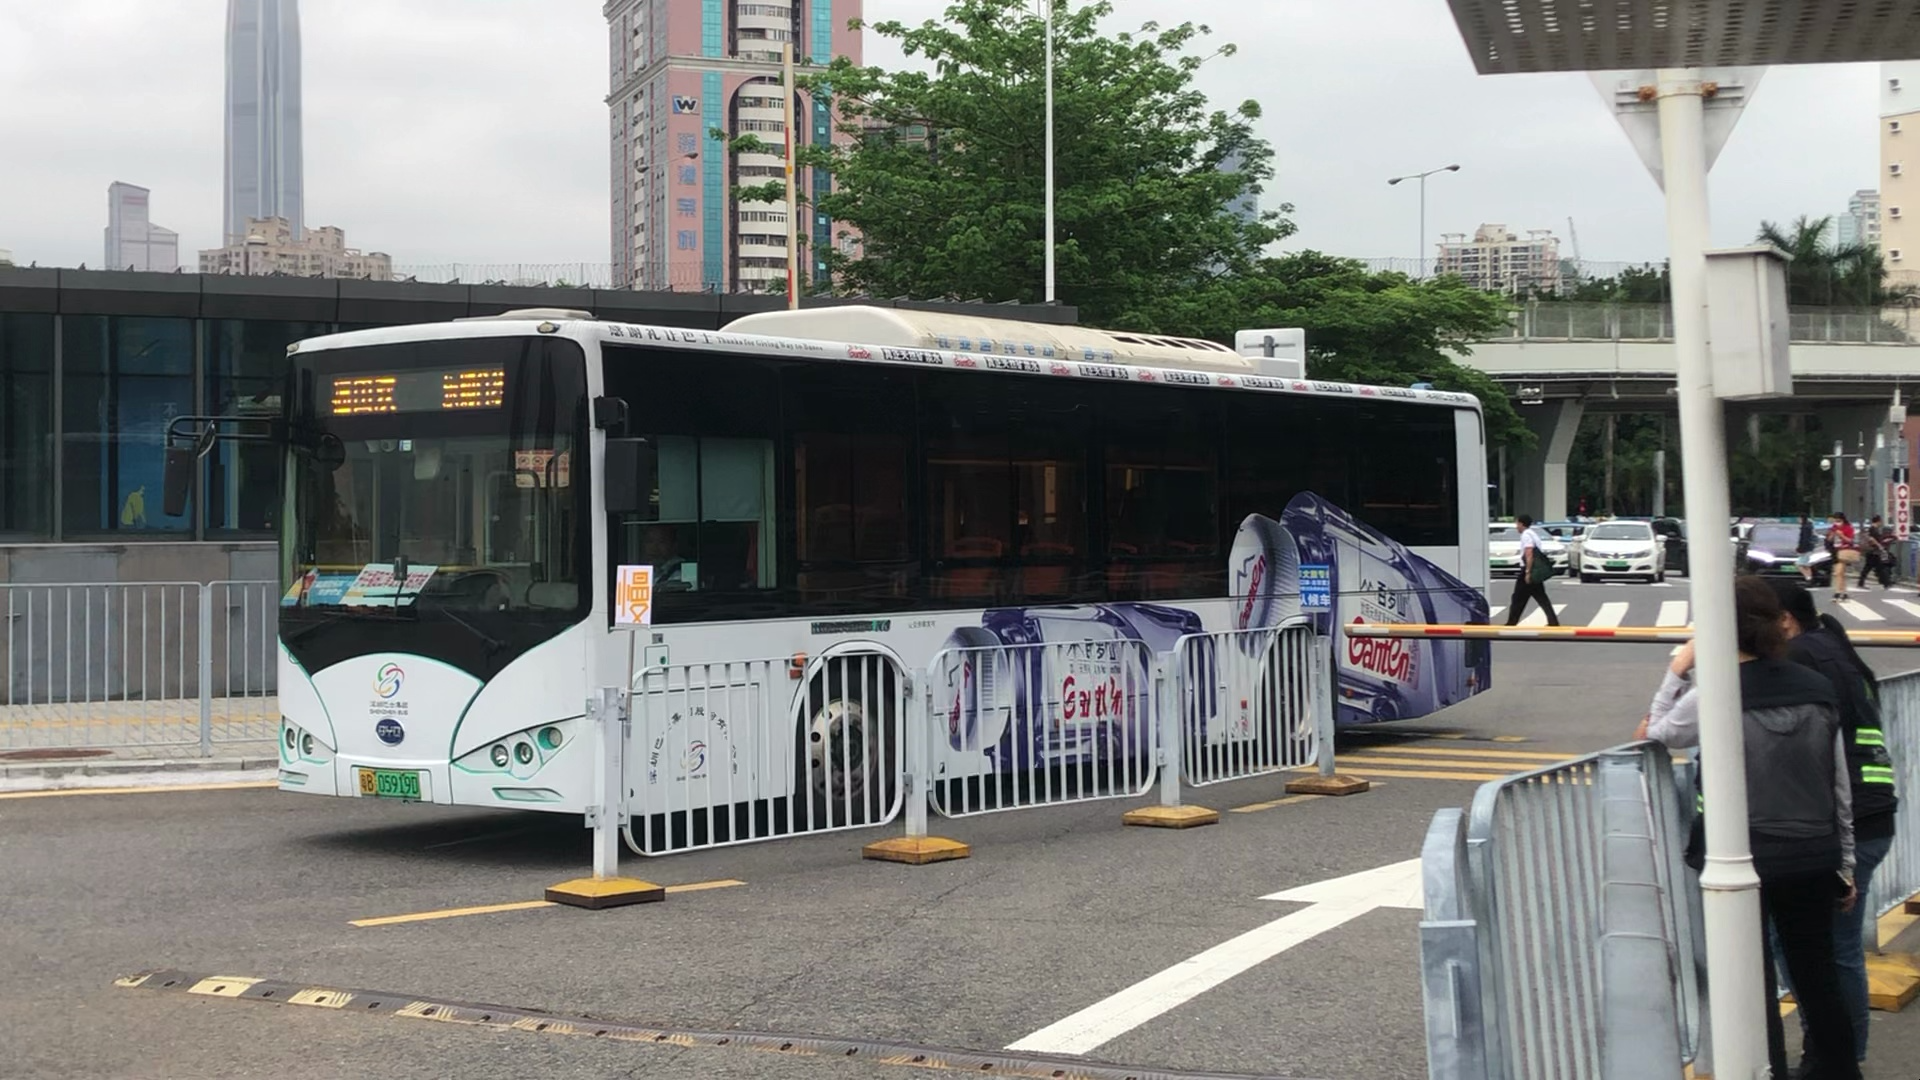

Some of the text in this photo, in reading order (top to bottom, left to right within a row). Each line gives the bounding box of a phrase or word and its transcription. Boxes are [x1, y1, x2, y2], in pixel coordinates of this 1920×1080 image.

[608, 325, 714, 345] 感谢礼让巴士
[618, 569, 649, 623] 慢
